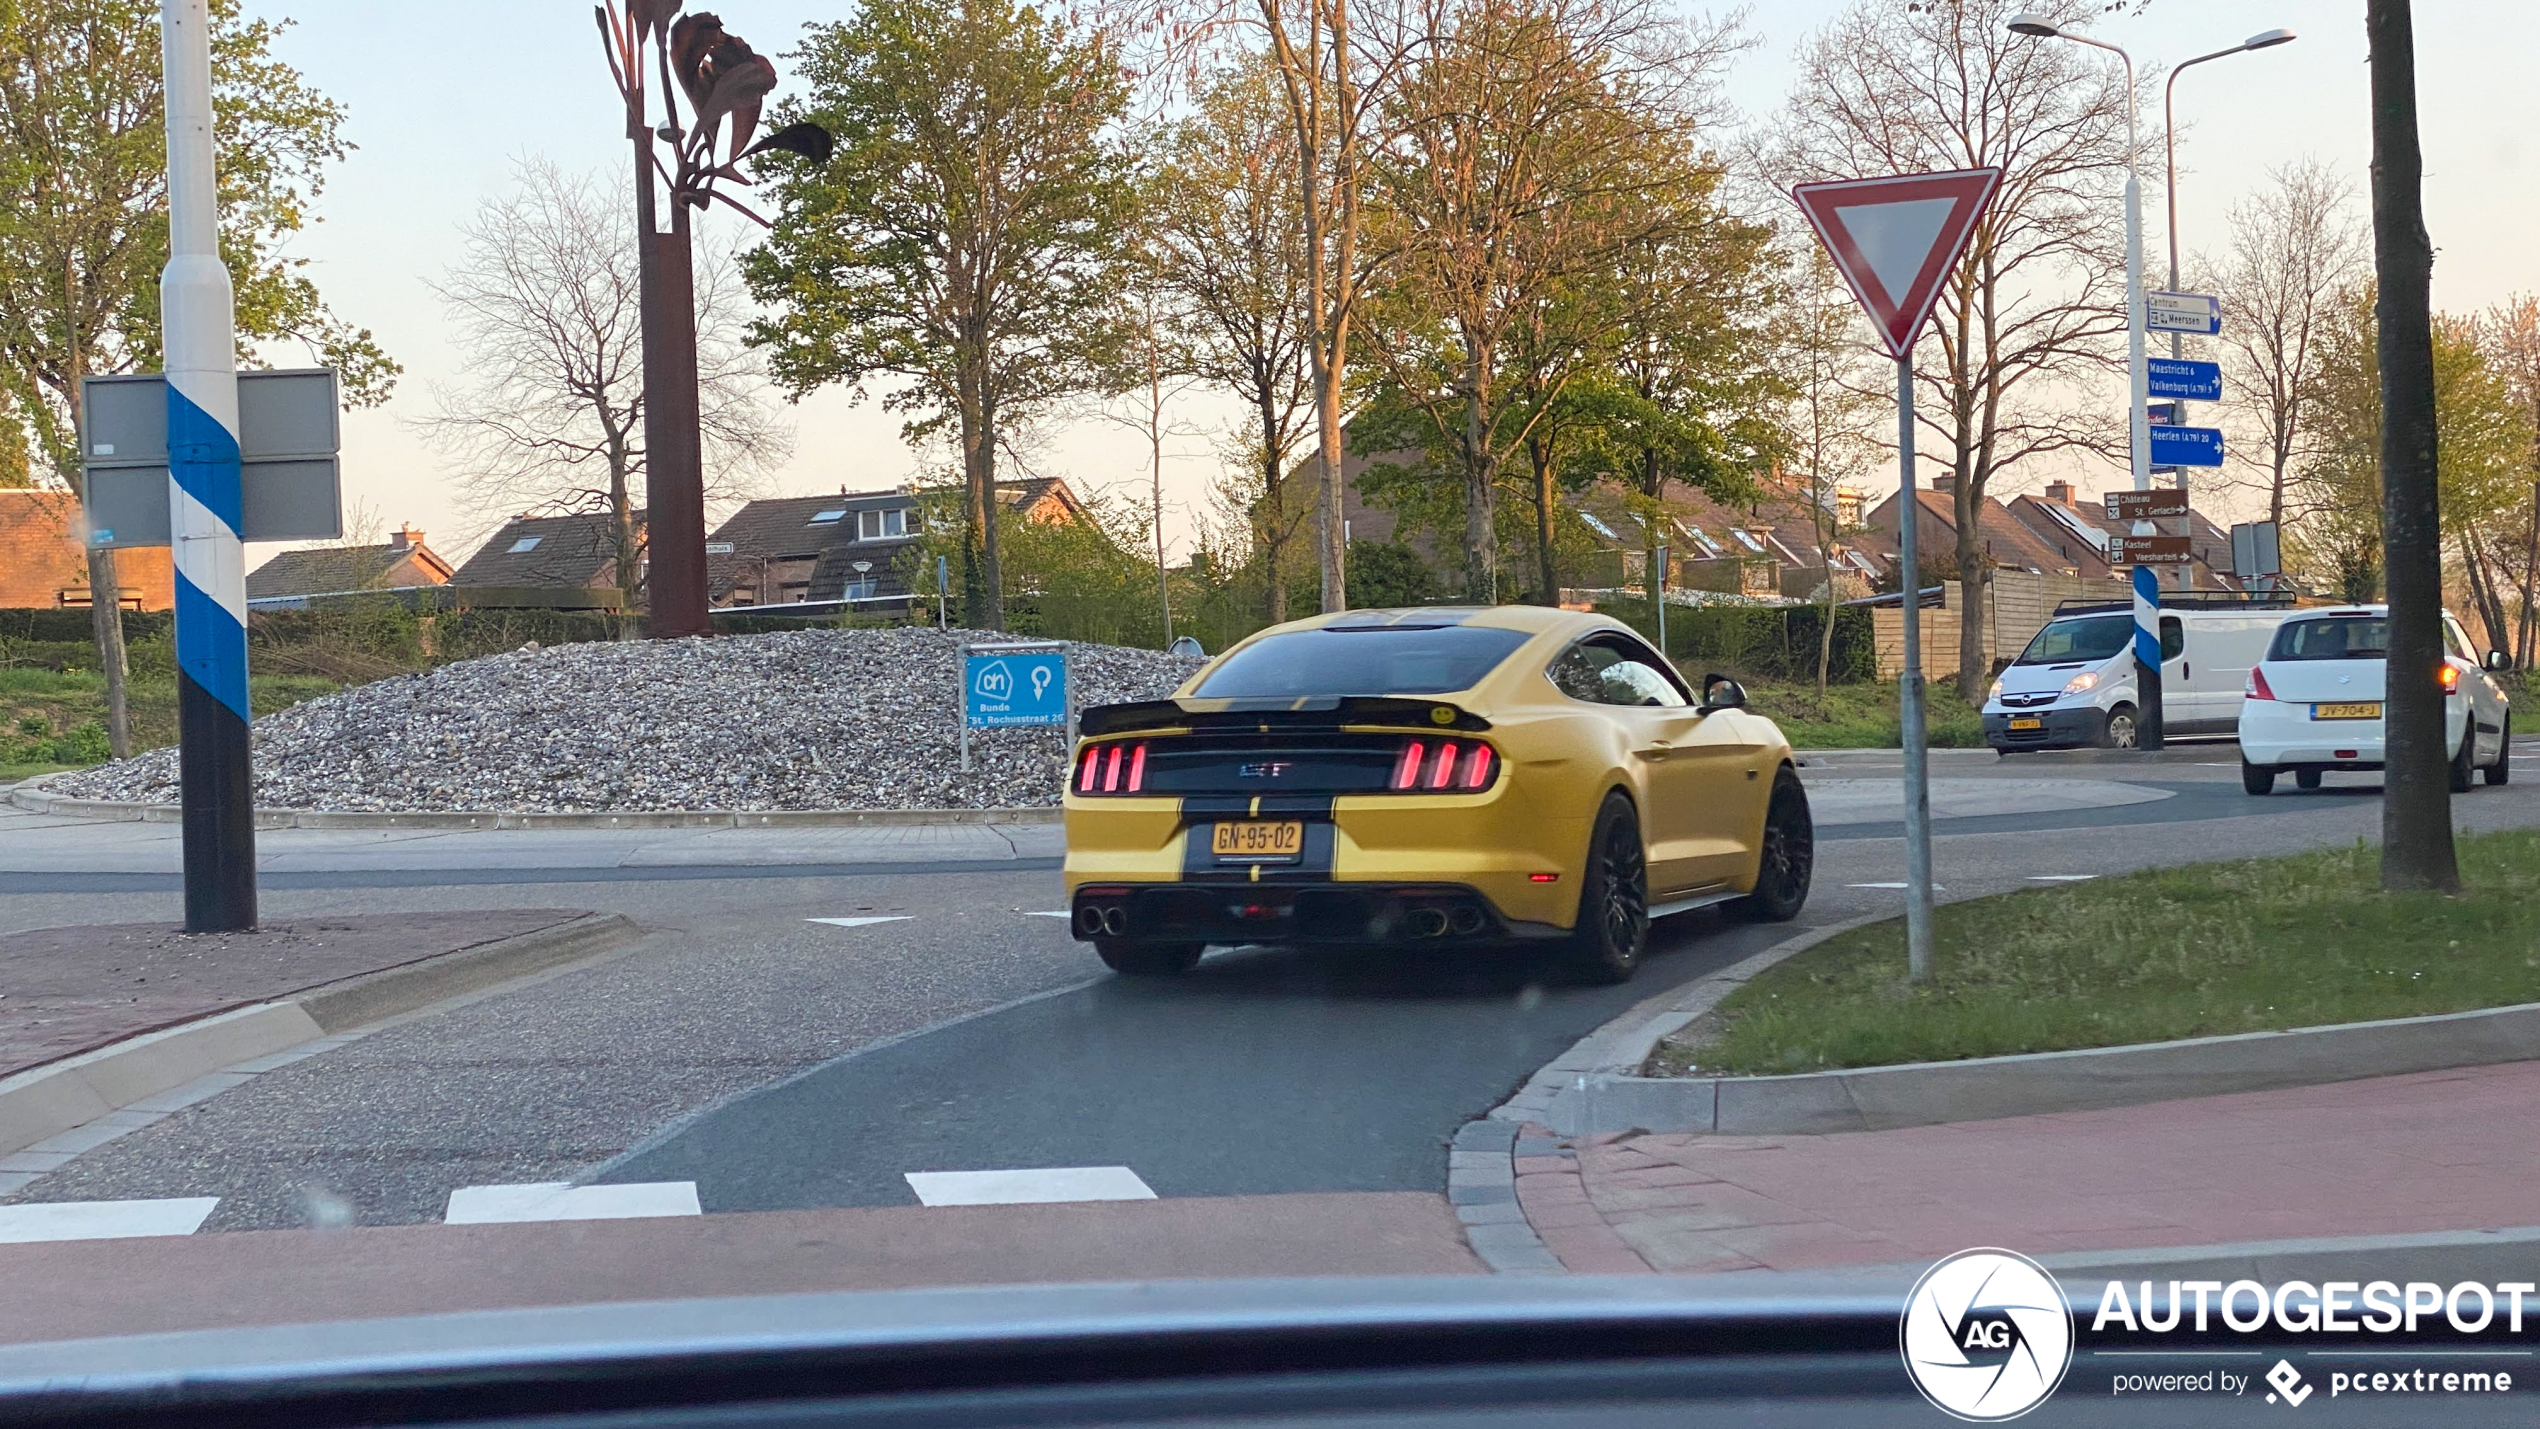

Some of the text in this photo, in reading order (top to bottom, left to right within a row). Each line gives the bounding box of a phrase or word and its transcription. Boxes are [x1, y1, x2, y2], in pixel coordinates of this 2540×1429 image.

[2150, 297, 2178, 308] Centrum
[2169, 313, 2200, 325] Meerssen
[2149, 362, 2195, 376] Maastricht 6
[2150, 380, 2188, 395] Valkenburg
[2208, 385, 2213, 394] 9
[2152, 430, 2180, 441] Heerlen
[2201, 434, 2210, 443] 20
[2148, 506, 2176, 516] Gerlach
[2124, 541, 2151, 549] Kasteel
[980, 702, 1010, 712] Bunde
[2322, 705, 2375, 716] JV-704-J
[971, 717, 984, 725] St.
[987, 714, 1049, 724] Rochusstraat
[1239, 763, 1292, 777] GT
[1218, 826, 1295, 849] GN-95-02
